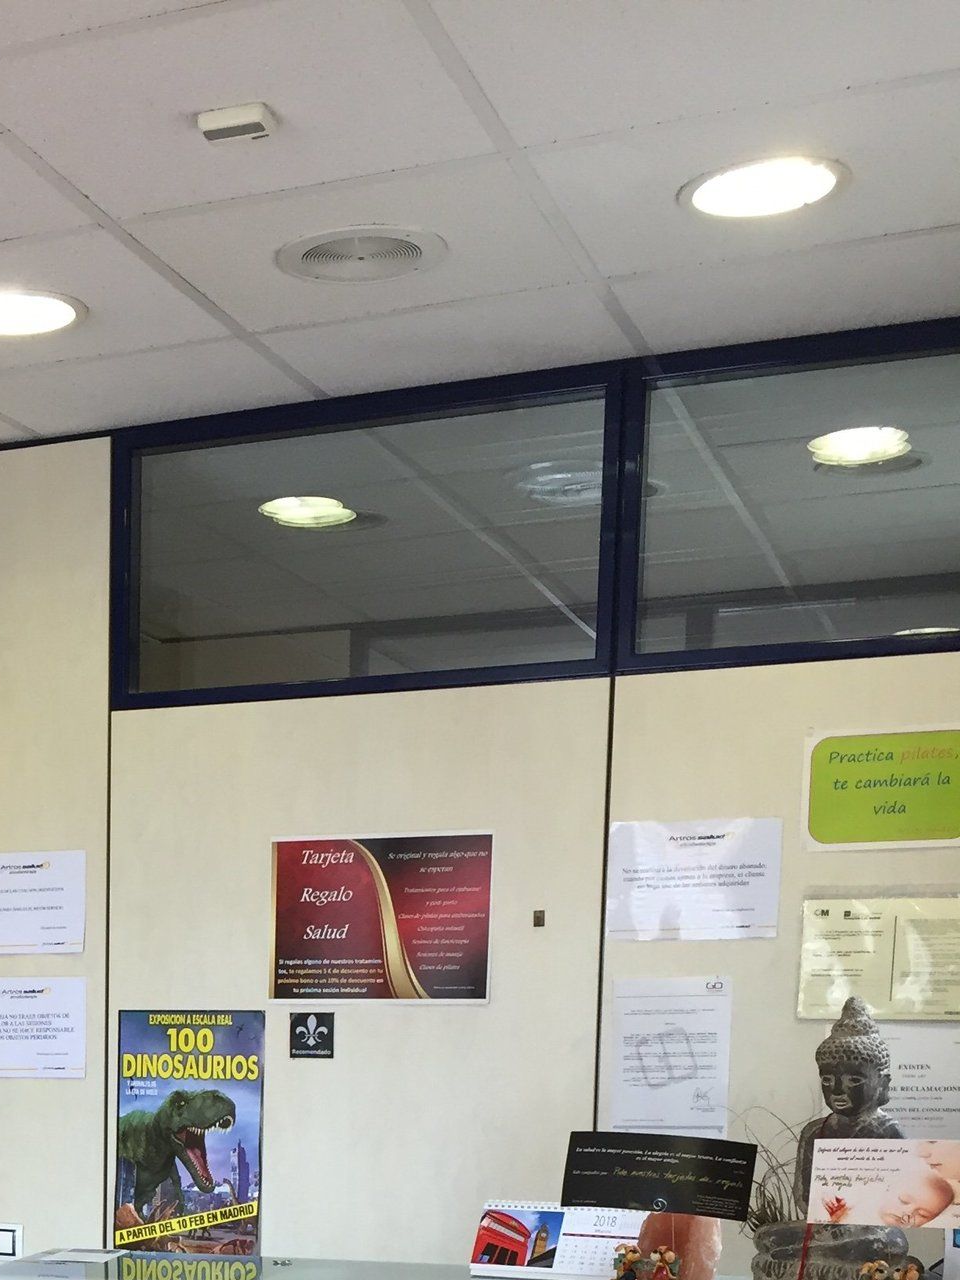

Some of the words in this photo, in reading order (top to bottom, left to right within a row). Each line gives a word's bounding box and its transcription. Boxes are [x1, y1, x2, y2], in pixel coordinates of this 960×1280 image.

[828, 748, 894, 764] Practica
[833, 778, 848, 790] te
[855, 773, 930, 790] cambiará
[937, 772, 951, 786] la
[874, 800, 907, 815] vida
[301, 849, 355, 868] Tarjeta
[396, 851, 421, 860] original
[300, 887, 353, 906] Regalo
[303, 924, 350, 940] Salud
[186, 1015, 192, 1024] A
[192, 1014, 216, 1025] ESCALA
[216, 1014, 232, 1026] REAL
[166, 1028, 214, 1053] 100
[122, 1053, 259, 1080] DINOSAURIOS
[119, 1232, 126, 1242] A
[126, 1225, 157, 1240] PARTIR
[160, 1222, 174, 1233] DEL
[177, 1218, 187, 1230] 10
[189, 1214, 206, 1226] FEB
[207, 1212, 218, 1224] EN
[220, 1204, 254, 1220] MADRID
[593, 1215, 618, 1228] 2018
